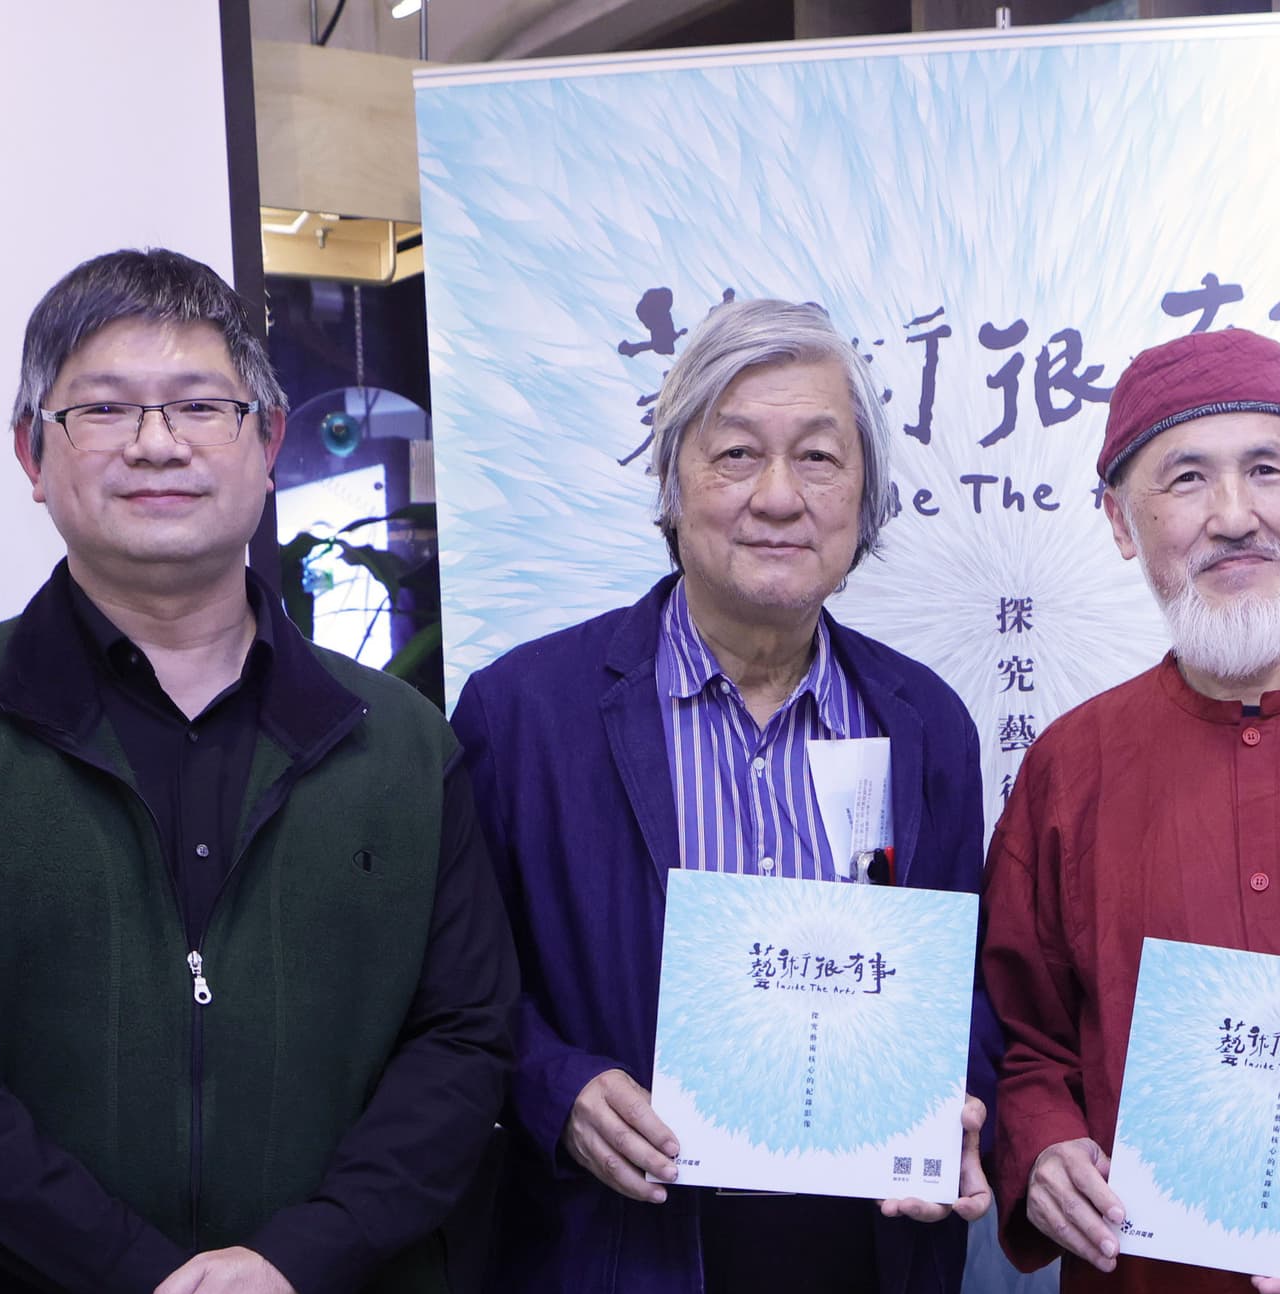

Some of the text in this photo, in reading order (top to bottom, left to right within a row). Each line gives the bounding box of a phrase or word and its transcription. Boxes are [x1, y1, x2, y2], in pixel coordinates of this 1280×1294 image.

[960, 474, 1060, 513] The
[747, 942, 896, 994] 藝術很有事
